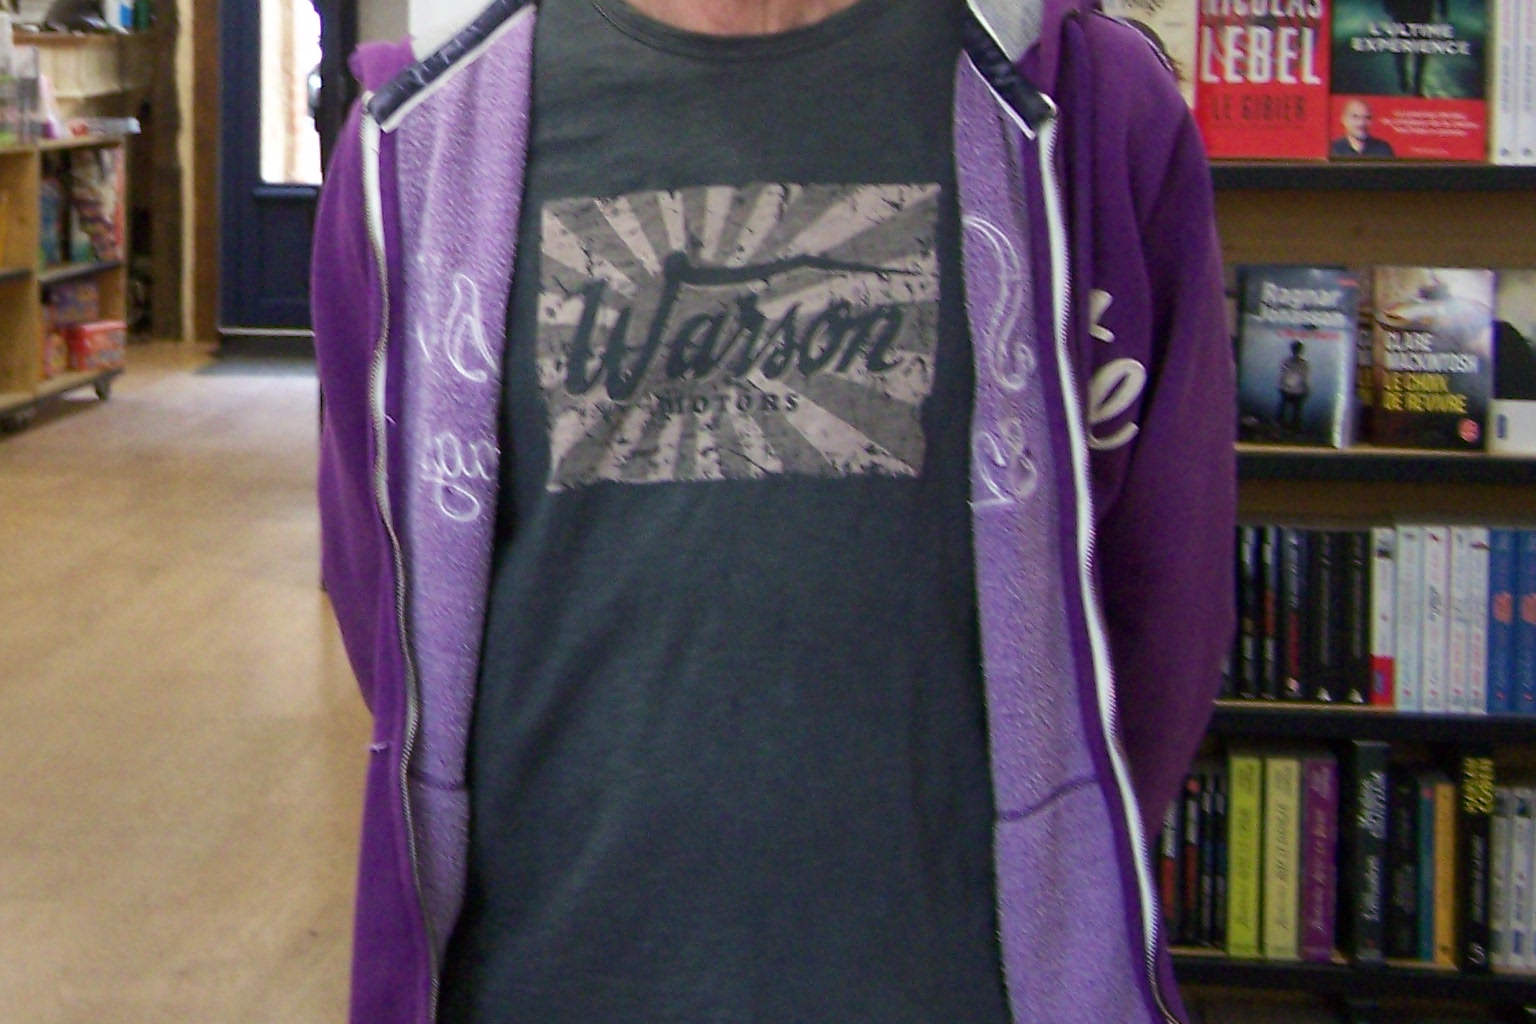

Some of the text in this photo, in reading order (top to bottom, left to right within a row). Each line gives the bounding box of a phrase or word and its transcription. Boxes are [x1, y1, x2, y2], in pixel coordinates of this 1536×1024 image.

[1201, 27, 1322, 85] LEBEL
[1212, 94, 1232, 121] LE
[564, 252, 936, 401] Warson
[664, 392, 799, 415] MOTORS
